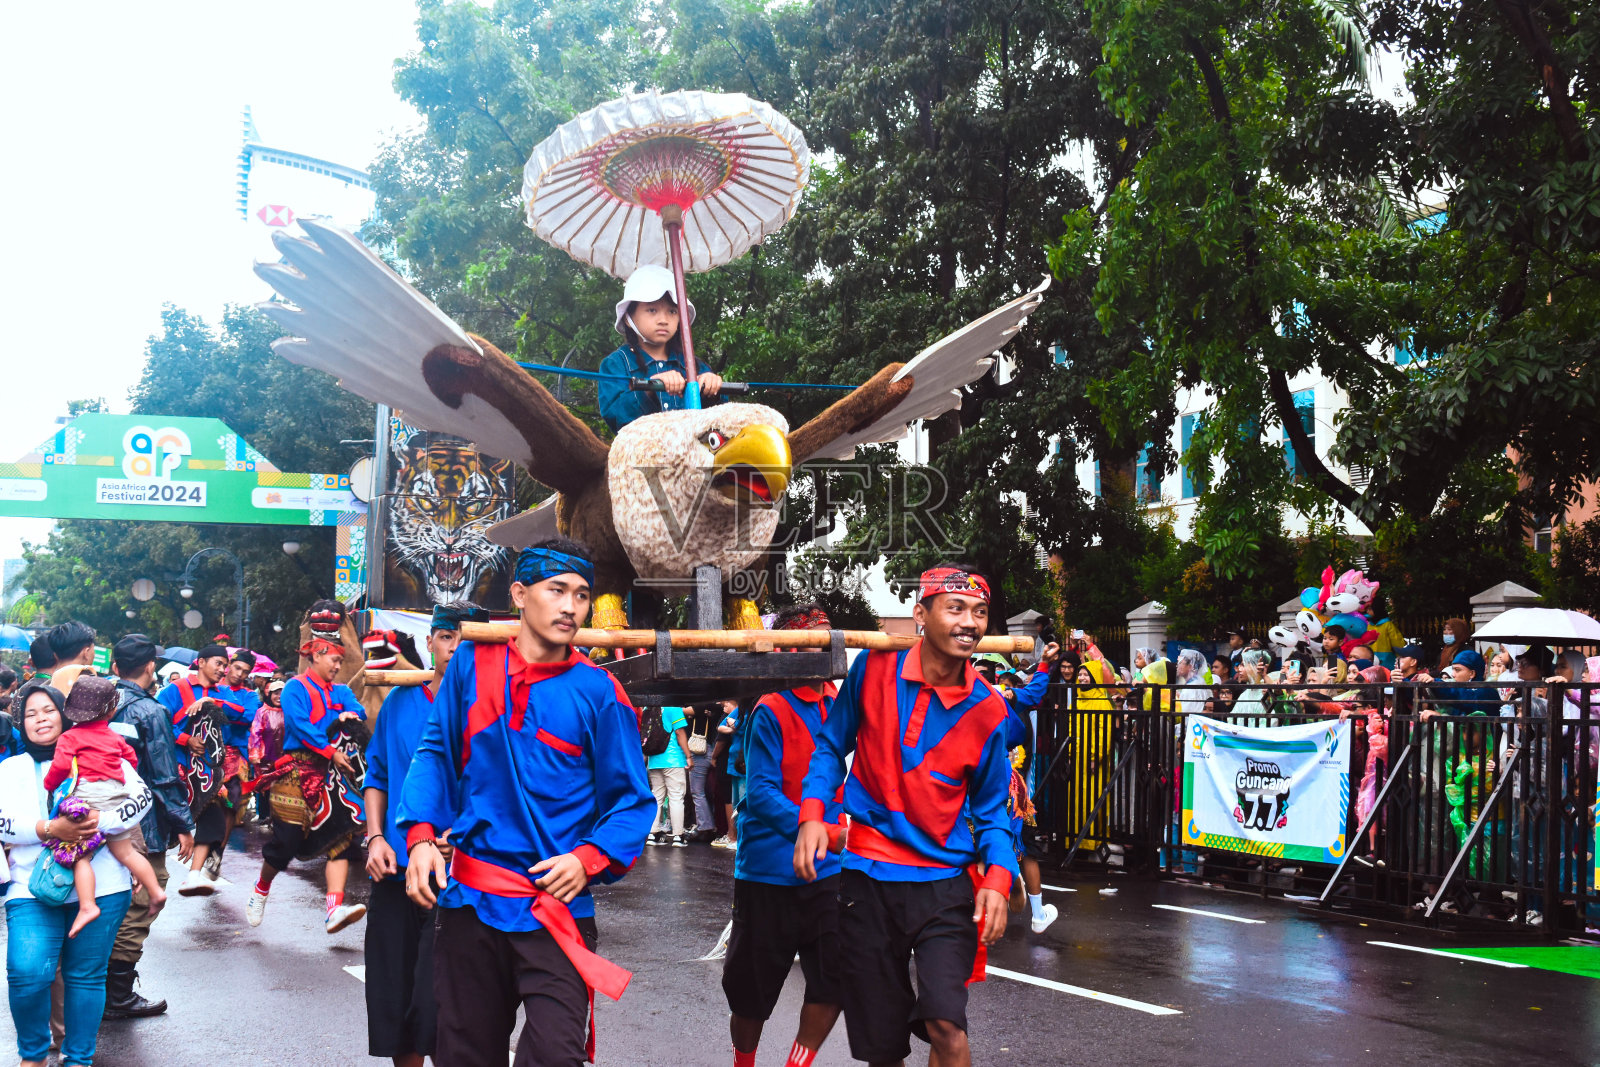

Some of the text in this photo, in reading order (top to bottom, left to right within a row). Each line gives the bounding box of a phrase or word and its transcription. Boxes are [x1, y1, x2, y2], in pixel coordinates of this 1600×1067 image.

[101, 484, 202, 503] Festival 2024
[121, 483, 146, 491] Africa
[1247, 758, 1280, 775] Promo
[1236, 770, 1292, 795] Guncang
[1244, 791, 1278, 830] 7.7
